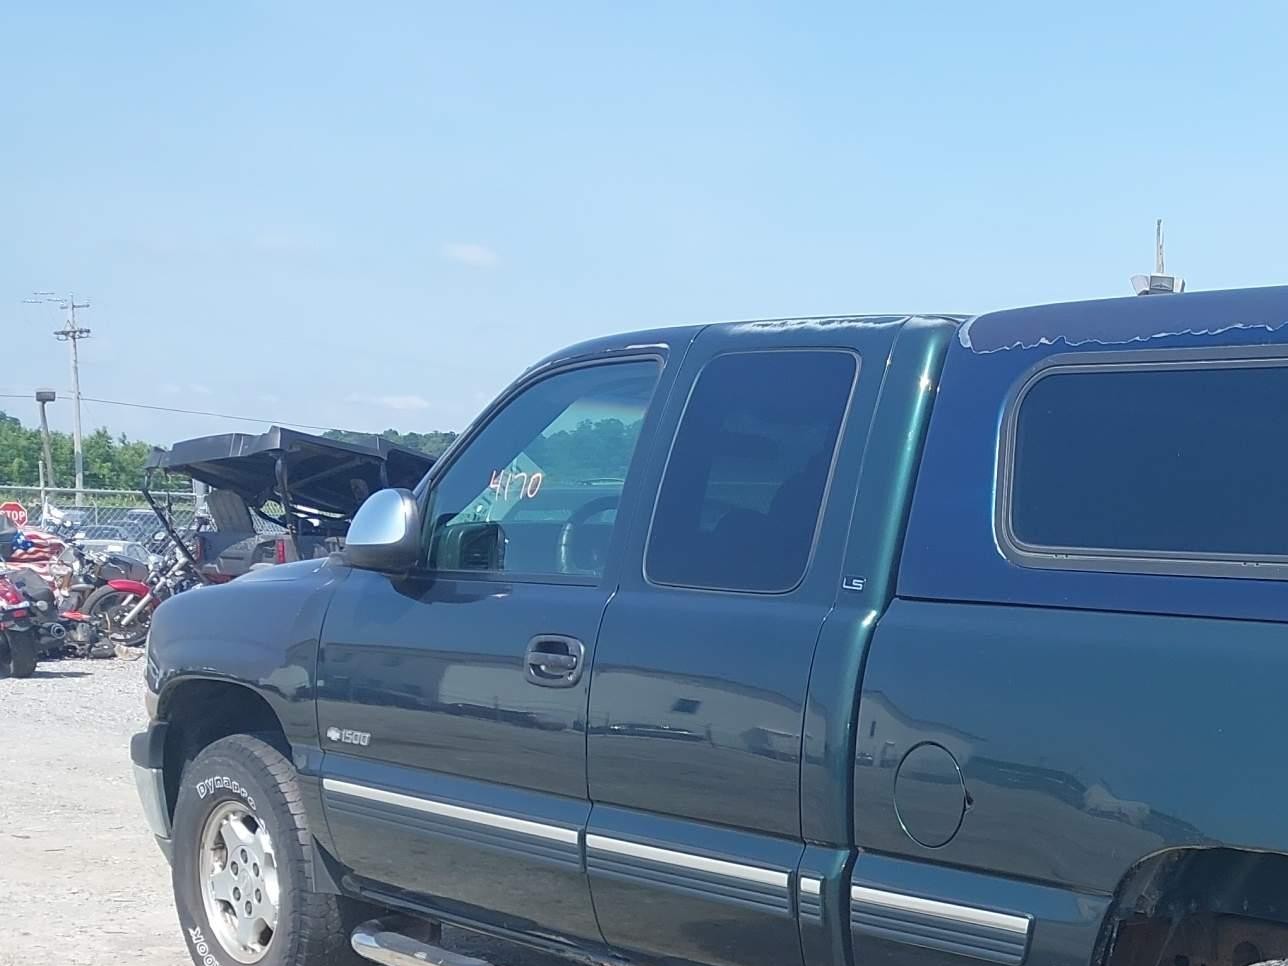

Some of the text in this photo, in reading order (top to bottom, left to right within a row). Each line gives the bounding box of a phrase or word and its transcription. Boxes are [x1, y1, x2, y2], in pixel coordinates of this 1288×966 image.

[489, 470, 542, 501] 4170
[843, 577, 864, 590] LS
[342, 728, 371, 746] 1500
